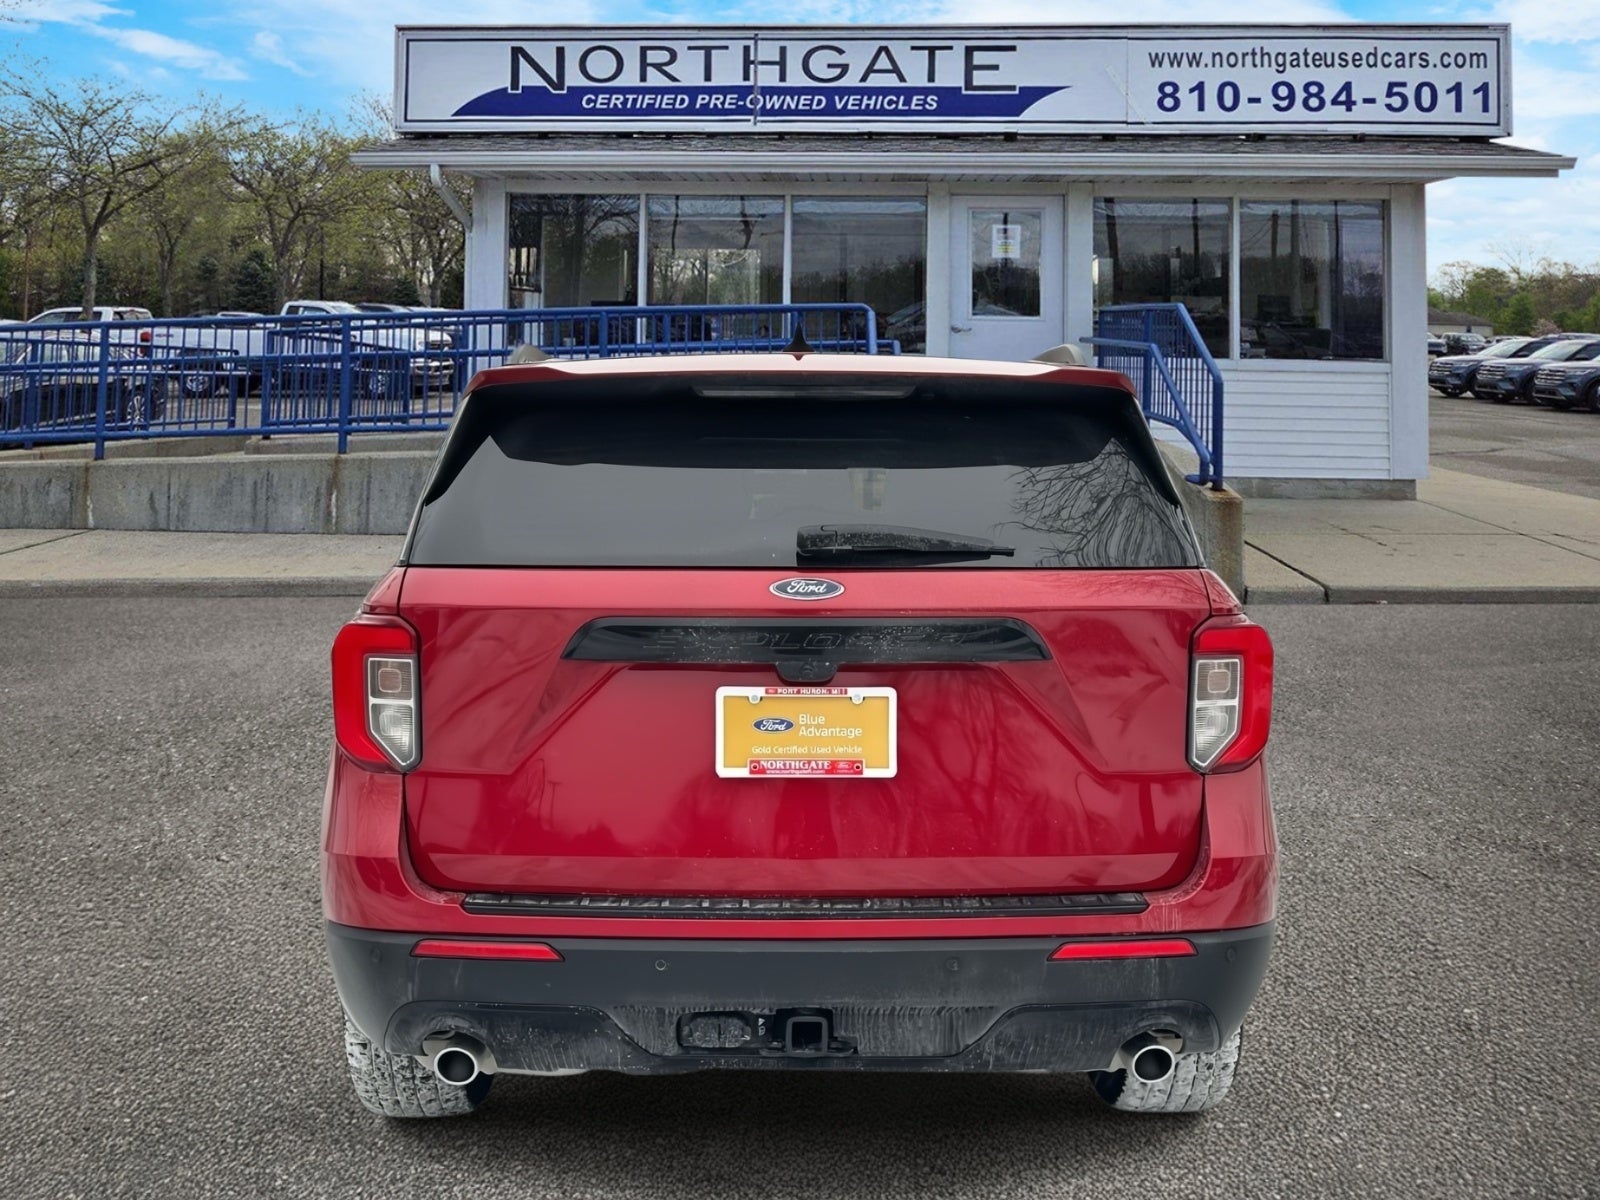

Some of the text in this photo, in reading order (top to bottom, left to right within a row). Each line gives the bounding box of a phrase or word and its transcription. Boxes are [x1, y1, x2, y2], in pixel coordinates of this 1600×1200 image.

[1148, 46, 1488, 74] www.northgateusedcars.com
[509, 44, 1018, 93] NORTHGATE
[581, 94, 939, 111] CERTIFIED PRE-OWNED VEHICLES
[1156, 80, 1490, 113] 810-984-5011
[786, 580, 827, 594] Ford
[760, 719, 787, 731] Ford
[798, 713, 825, 725] Blue
[798, 726, 863, 739] Advantage
[751, 745, 863, 754] Gold Certified Used Vehicle
[759, 760, 831, 770] NORTHGATE
